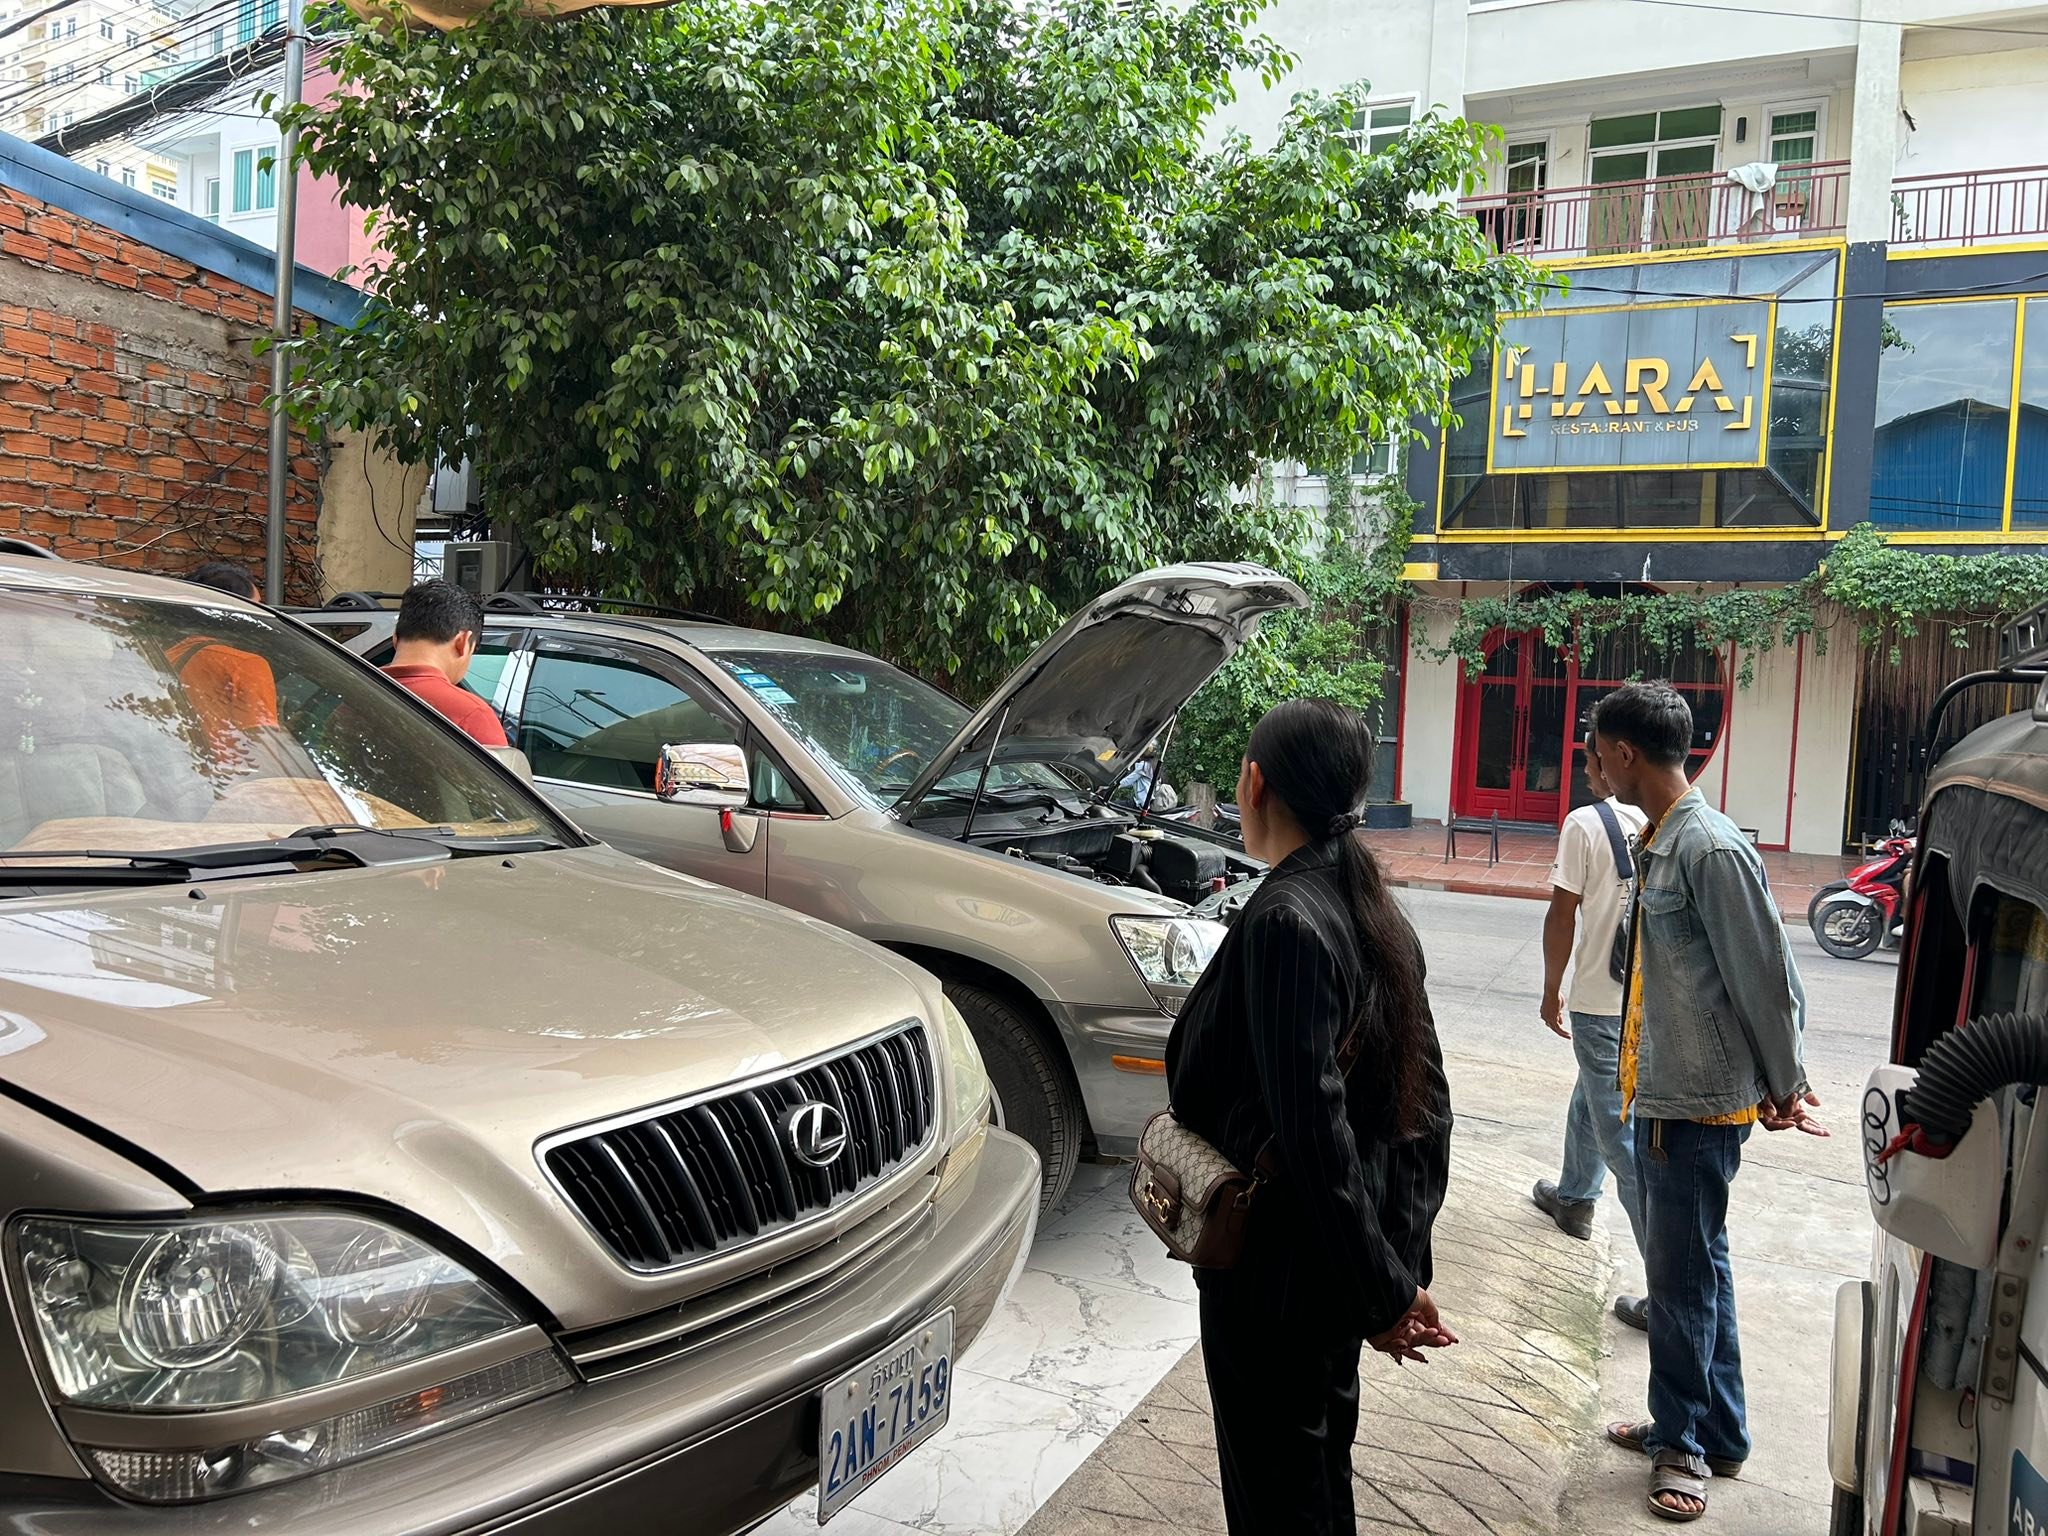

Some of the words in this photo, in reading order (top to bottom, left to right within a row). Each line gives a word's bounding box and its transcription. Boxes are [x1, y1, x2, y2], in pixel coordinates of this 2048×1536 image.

[1519, 357, 1734, 419] HARA
[1666, 419, 1698, 432] PUB
[827, 1355, 948, 1494] 2AN-7159
[861, 1458, 891, 1485] PHNOM
[893, 1437, 912, 1461] PENH
